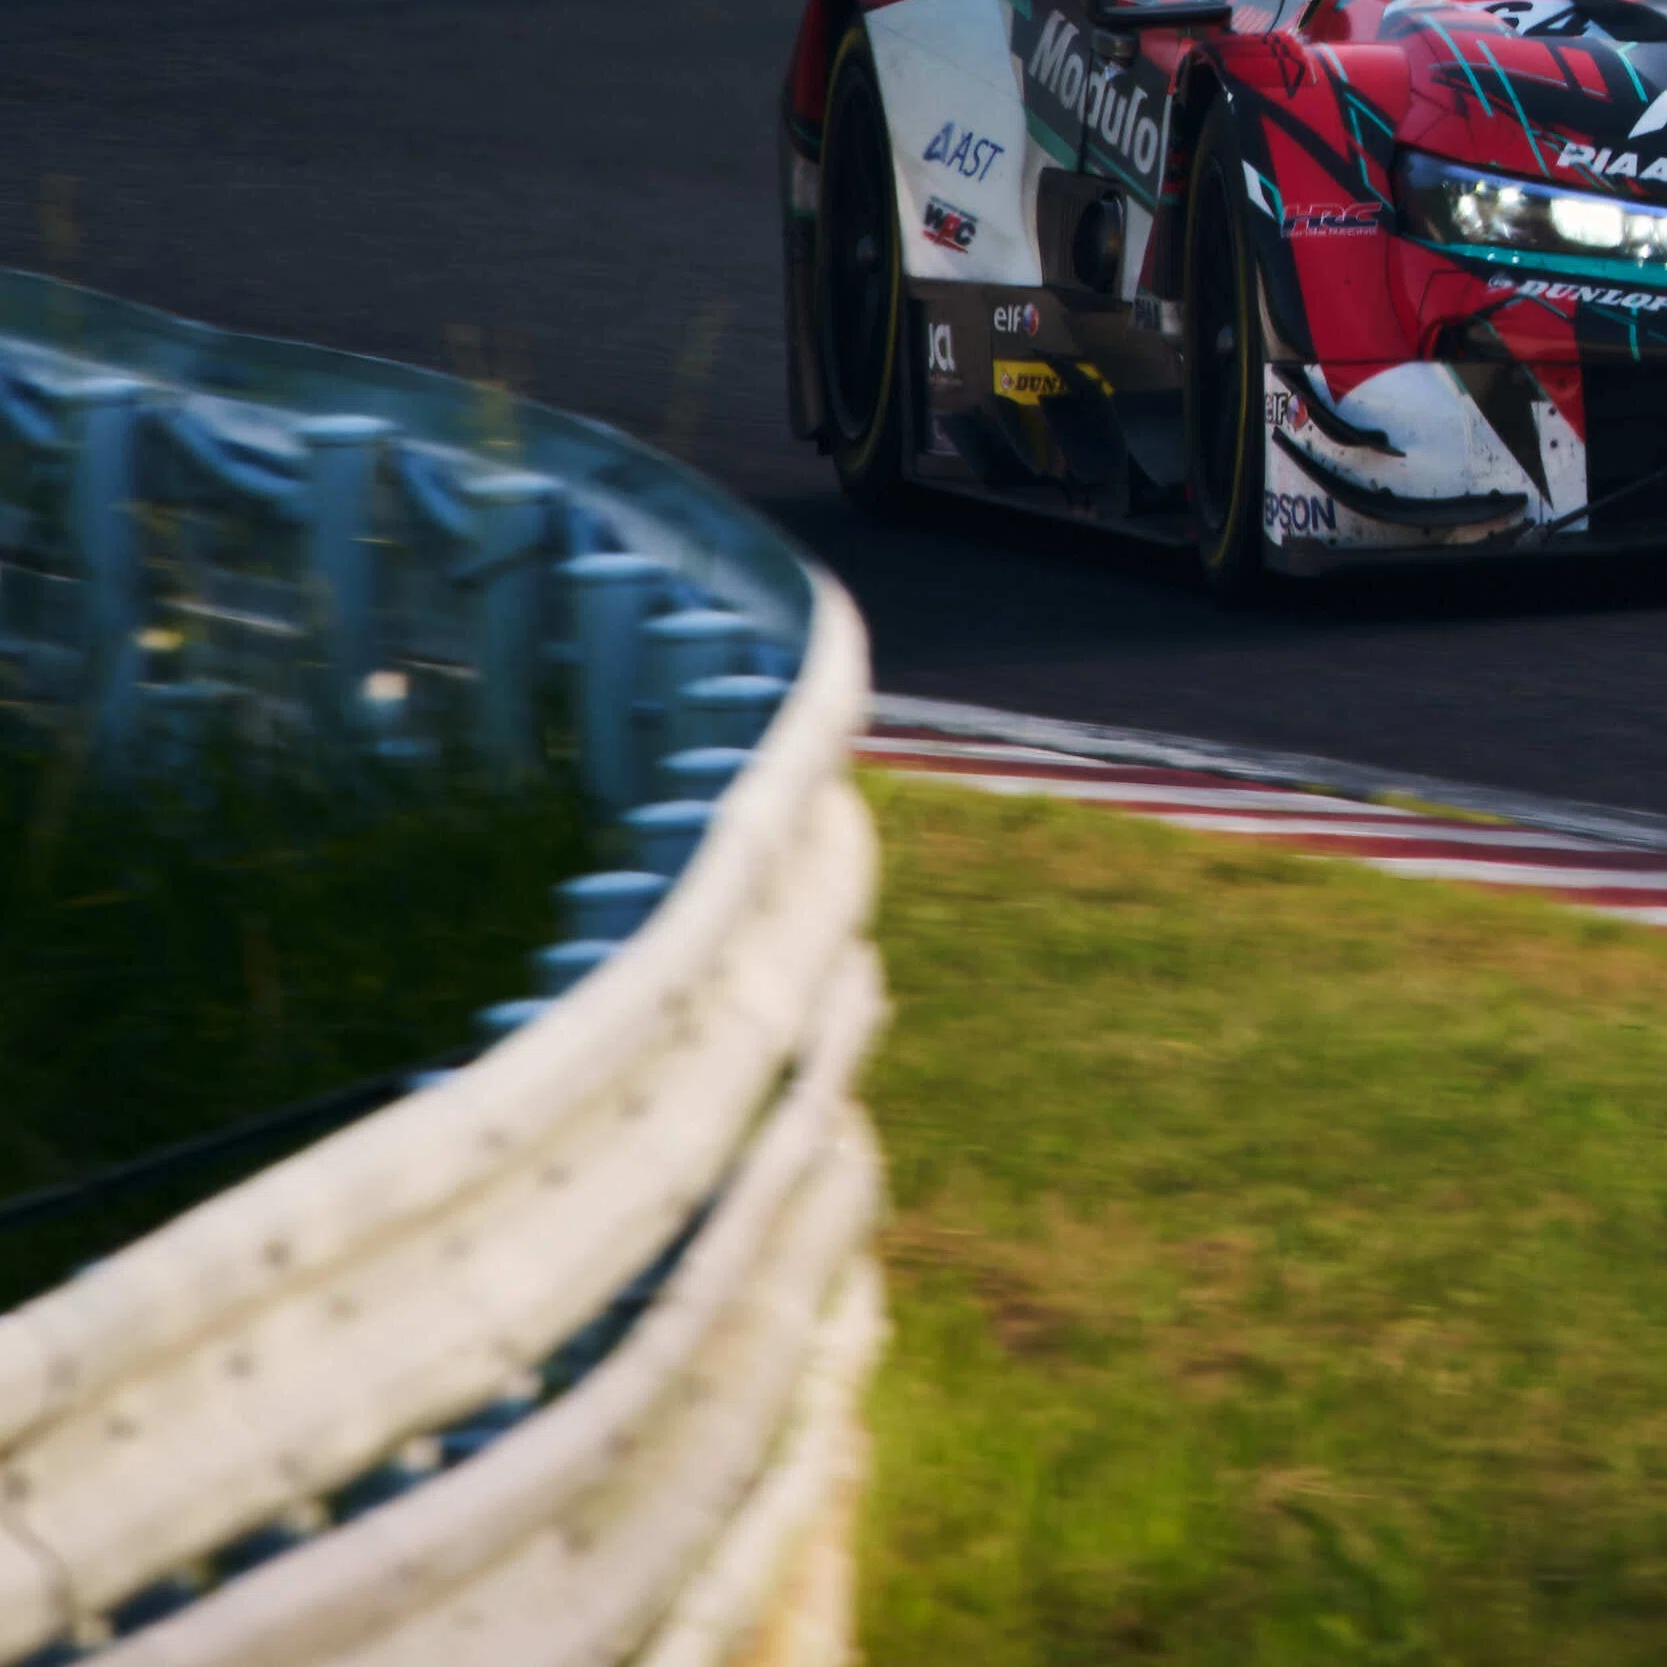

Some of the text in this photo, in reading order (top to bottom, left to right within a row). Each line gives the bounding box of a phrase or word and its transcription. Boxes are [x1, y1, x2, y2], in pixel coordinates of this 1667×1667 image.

[1027, 9, 1160, 175] Modulo
[1281, 201, 1382, 232] HRC
[993, 304, 1022, 332] elf
[1015, 373, 1070, 393] DUN
